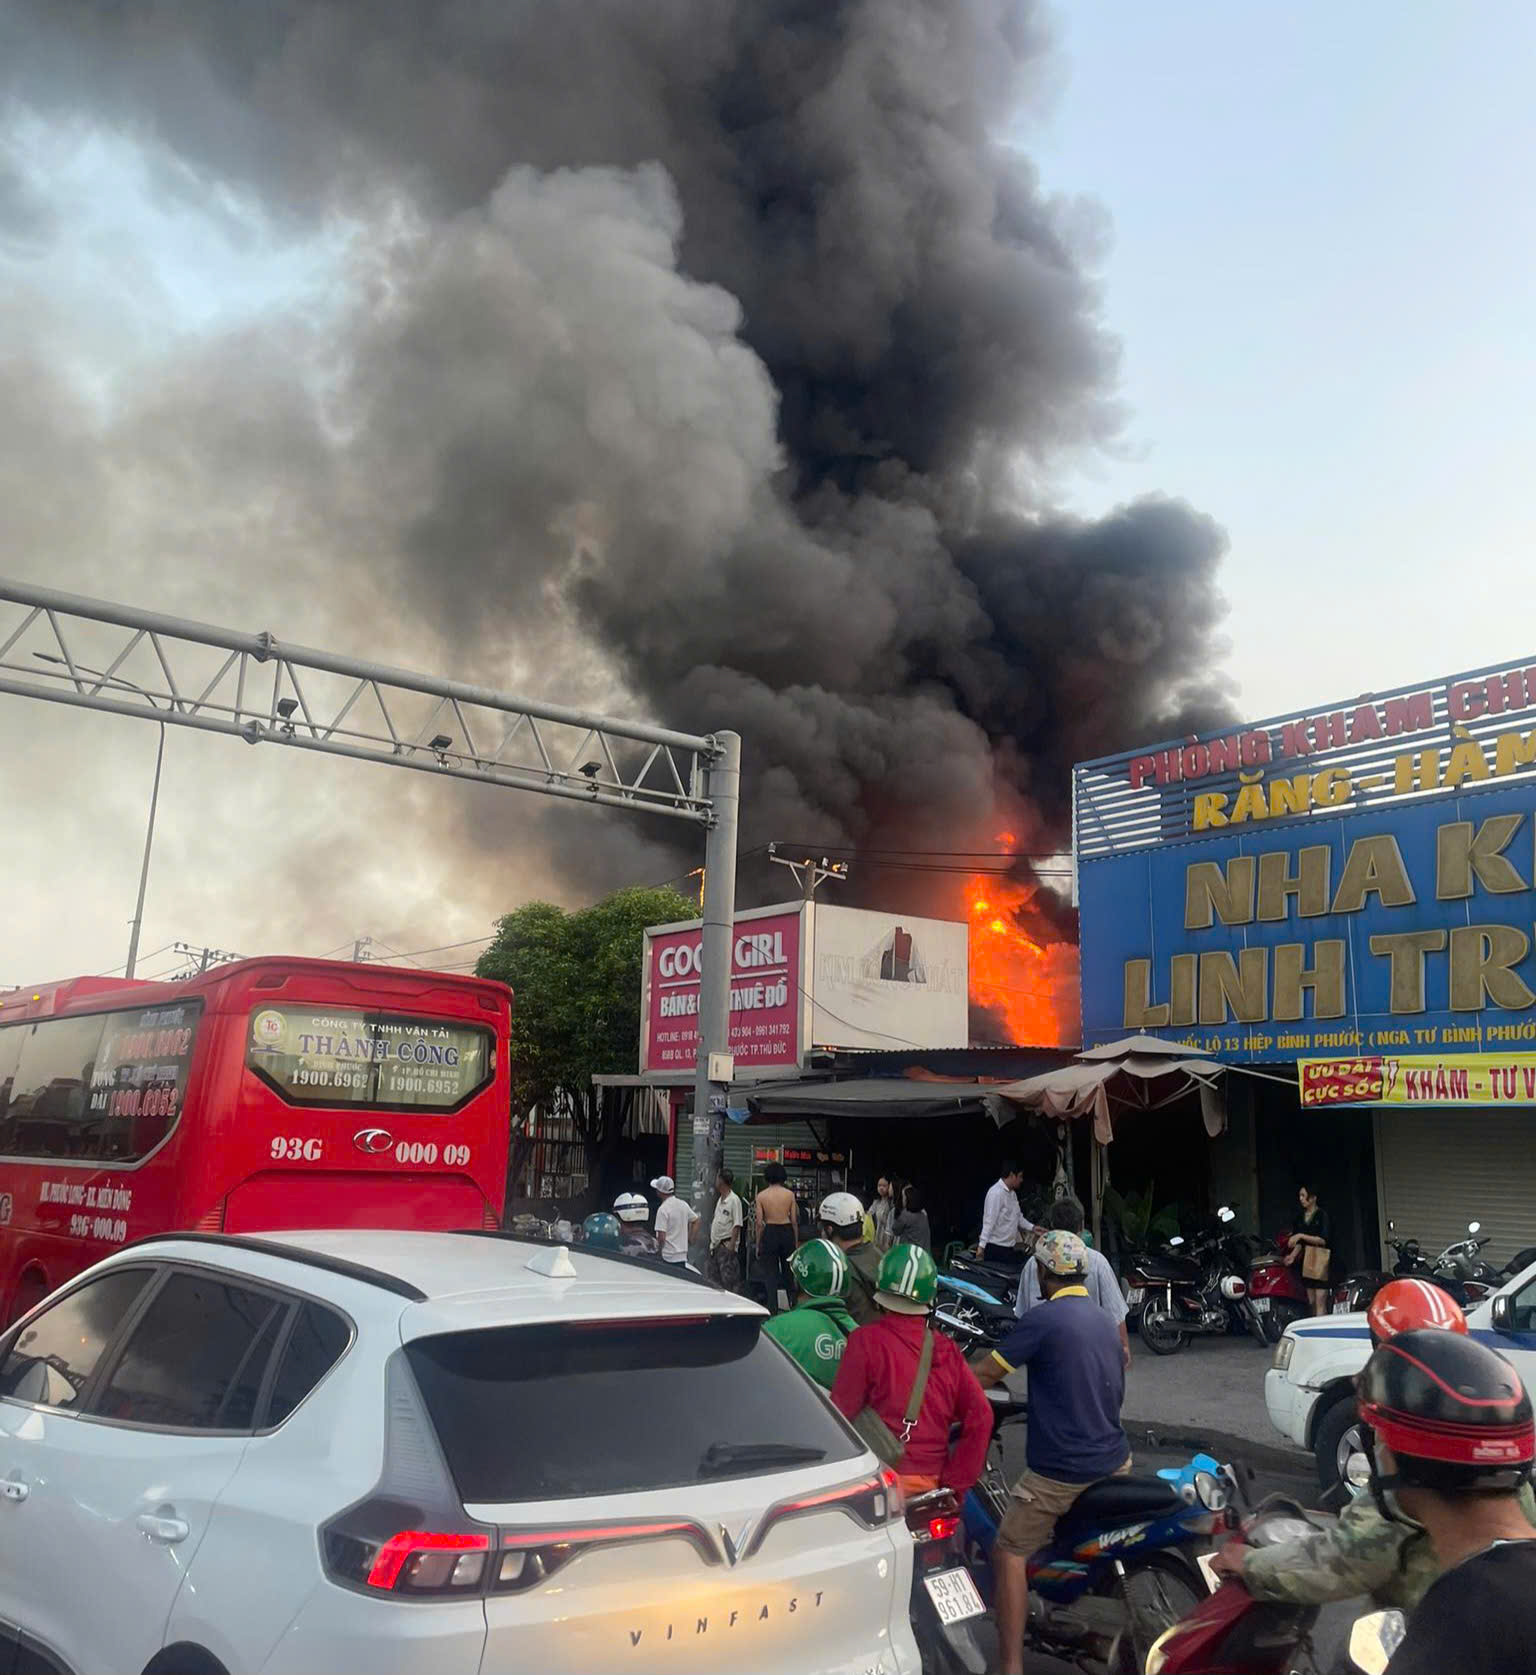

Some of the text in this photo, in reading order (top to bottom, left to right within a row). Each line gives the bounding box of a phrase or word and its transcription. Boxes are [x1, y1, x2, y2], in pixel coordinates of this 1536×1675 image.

[1129, 734, 1273, 790] PHÒNG
[1184, 813, 1536, 929] NHA K
[735, 931, 788, 968] GIRL
[1124, 922, 1536, 1029] LINH TR
[312, 1017, 348, 1030] CÔNG
[370, 1023, 402, 1035] TNHH
[1224, 1037, 1240, 1052] 13
[1277, 1030, 1310, 1049] BÌNH
[1442, 1022, 1482, 1043] BÌNH
[1487, 1017, 1536, 1041] PHƯỚ
[298, 1031, 460, 1067] THÀNH CÔNG
[390, 1076, 460, 1096] 1900.6952
[1405, 1063, 1469, 1100] KHÁM
[270, 1136, 471, 1166] 93G 000 09
[815, 1333, 847, 1360] Gr
[629, 1590, 824, 1648] VINFAST
